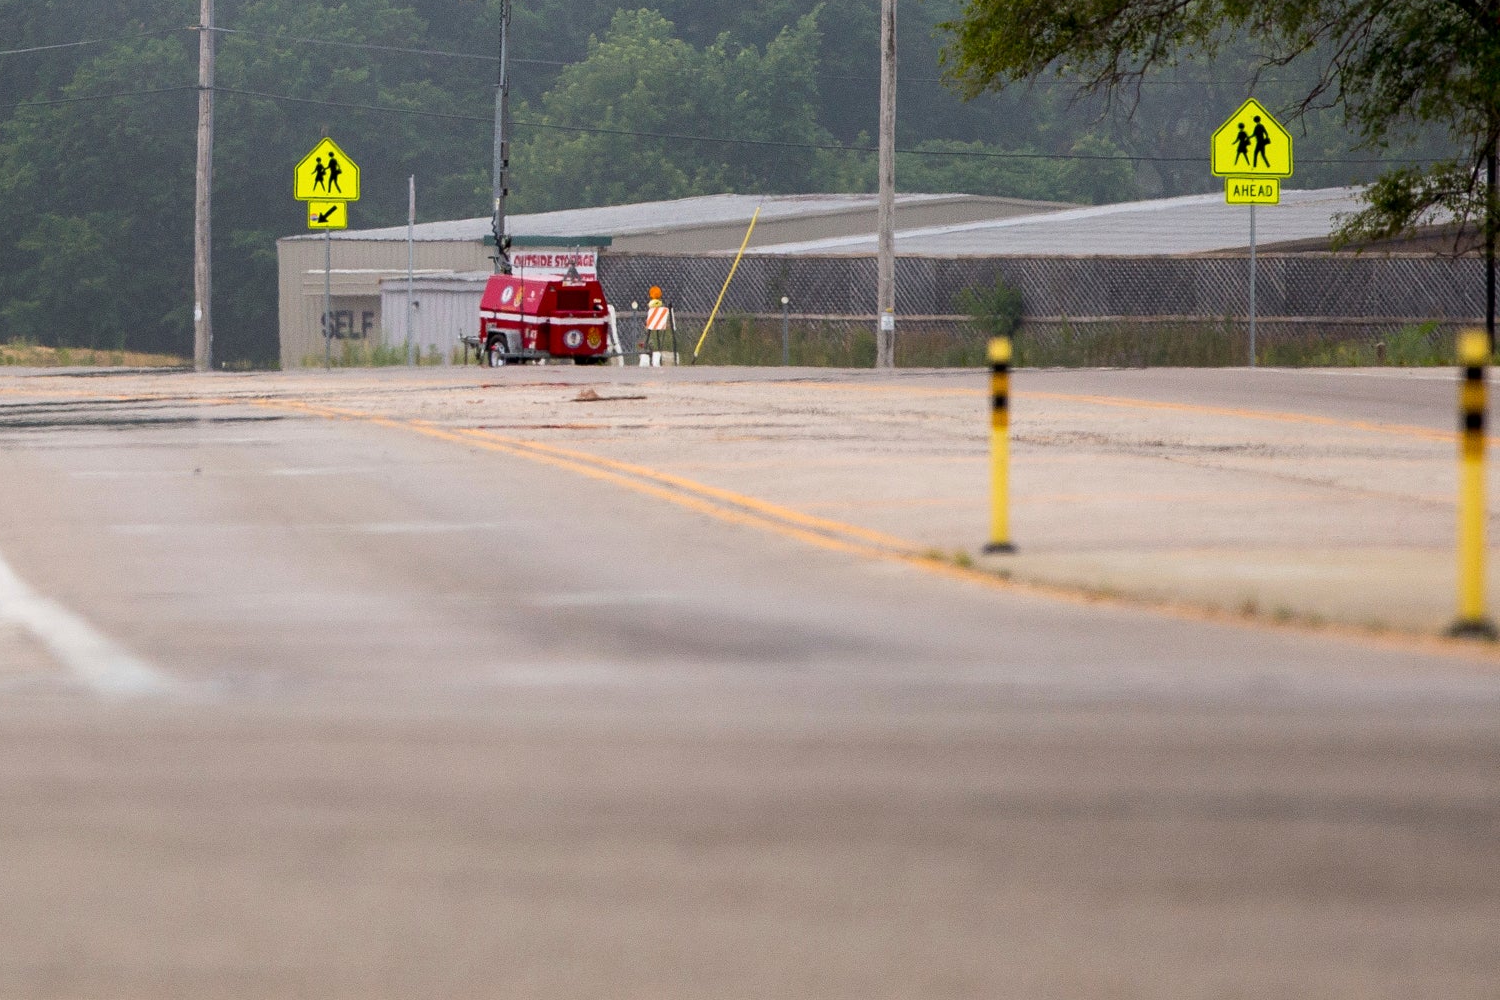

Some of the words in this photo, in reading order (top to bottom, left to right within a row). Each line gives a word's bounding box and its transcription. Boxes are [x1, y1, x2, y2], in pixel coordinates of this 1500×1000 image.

[1233, 184, 1273, 197] AHEAD
[514, 254, 553, 268] OUTSIDE
[321, 310, 374, 340] SELF
